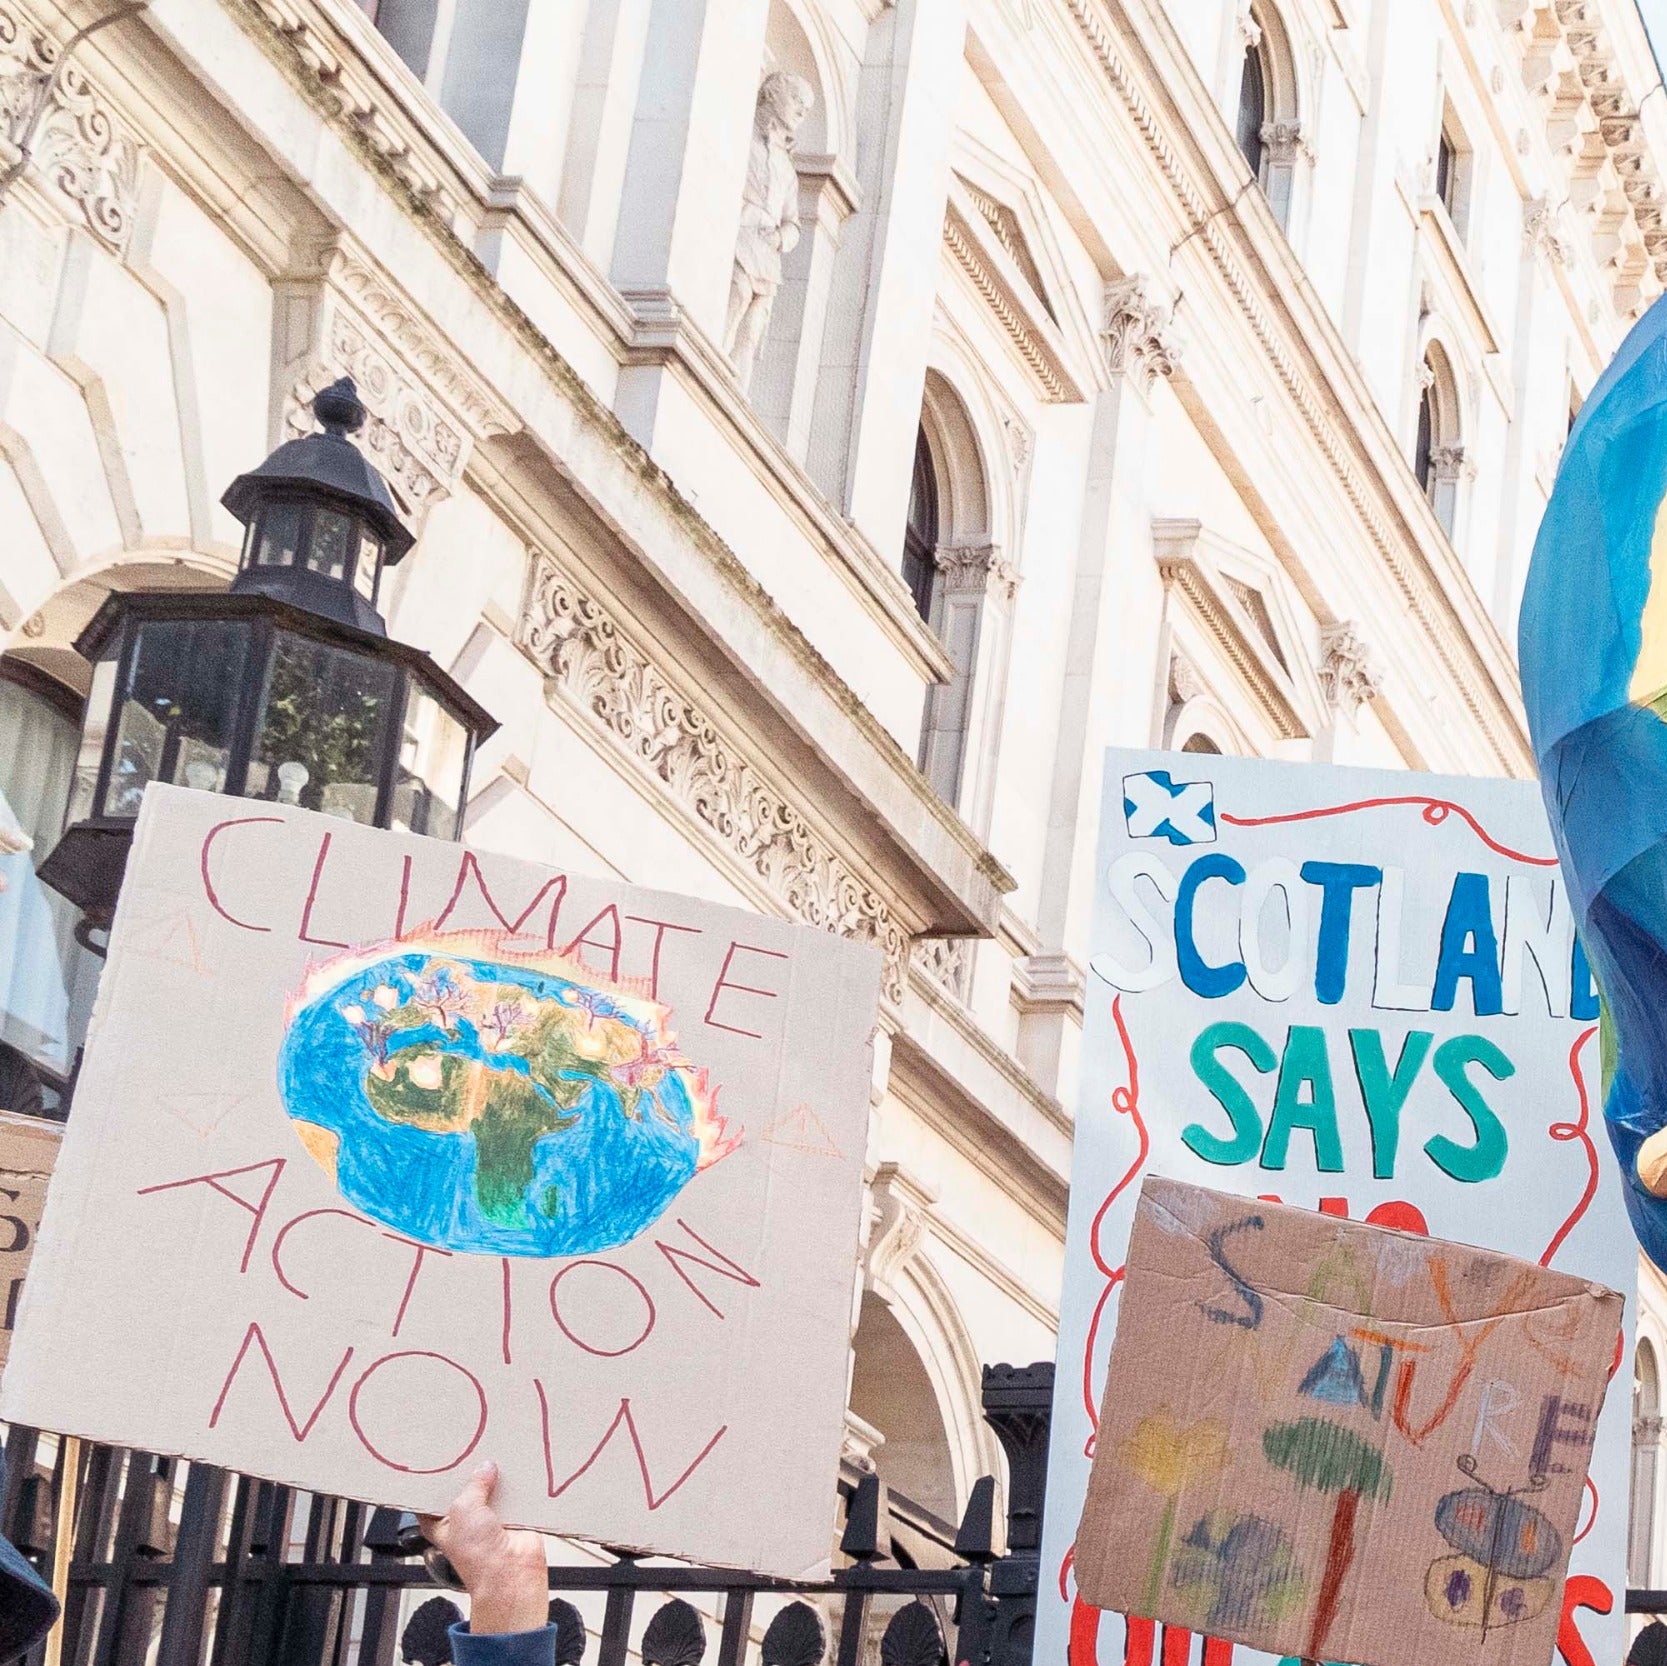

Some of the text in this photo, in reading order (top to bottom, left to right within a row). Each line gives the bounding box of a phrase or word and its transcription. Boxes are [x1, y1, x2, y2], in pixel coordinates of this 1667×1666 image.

[200, 817, 789, 1039] CLIMATE
[1181, 1020, 1516, 1182] SAYS
[137, 1158, 761, 1364] ACTION
[209, 1322, 728, 1511] NOW
[1202, 1327, 1594, 1476] NATURE
